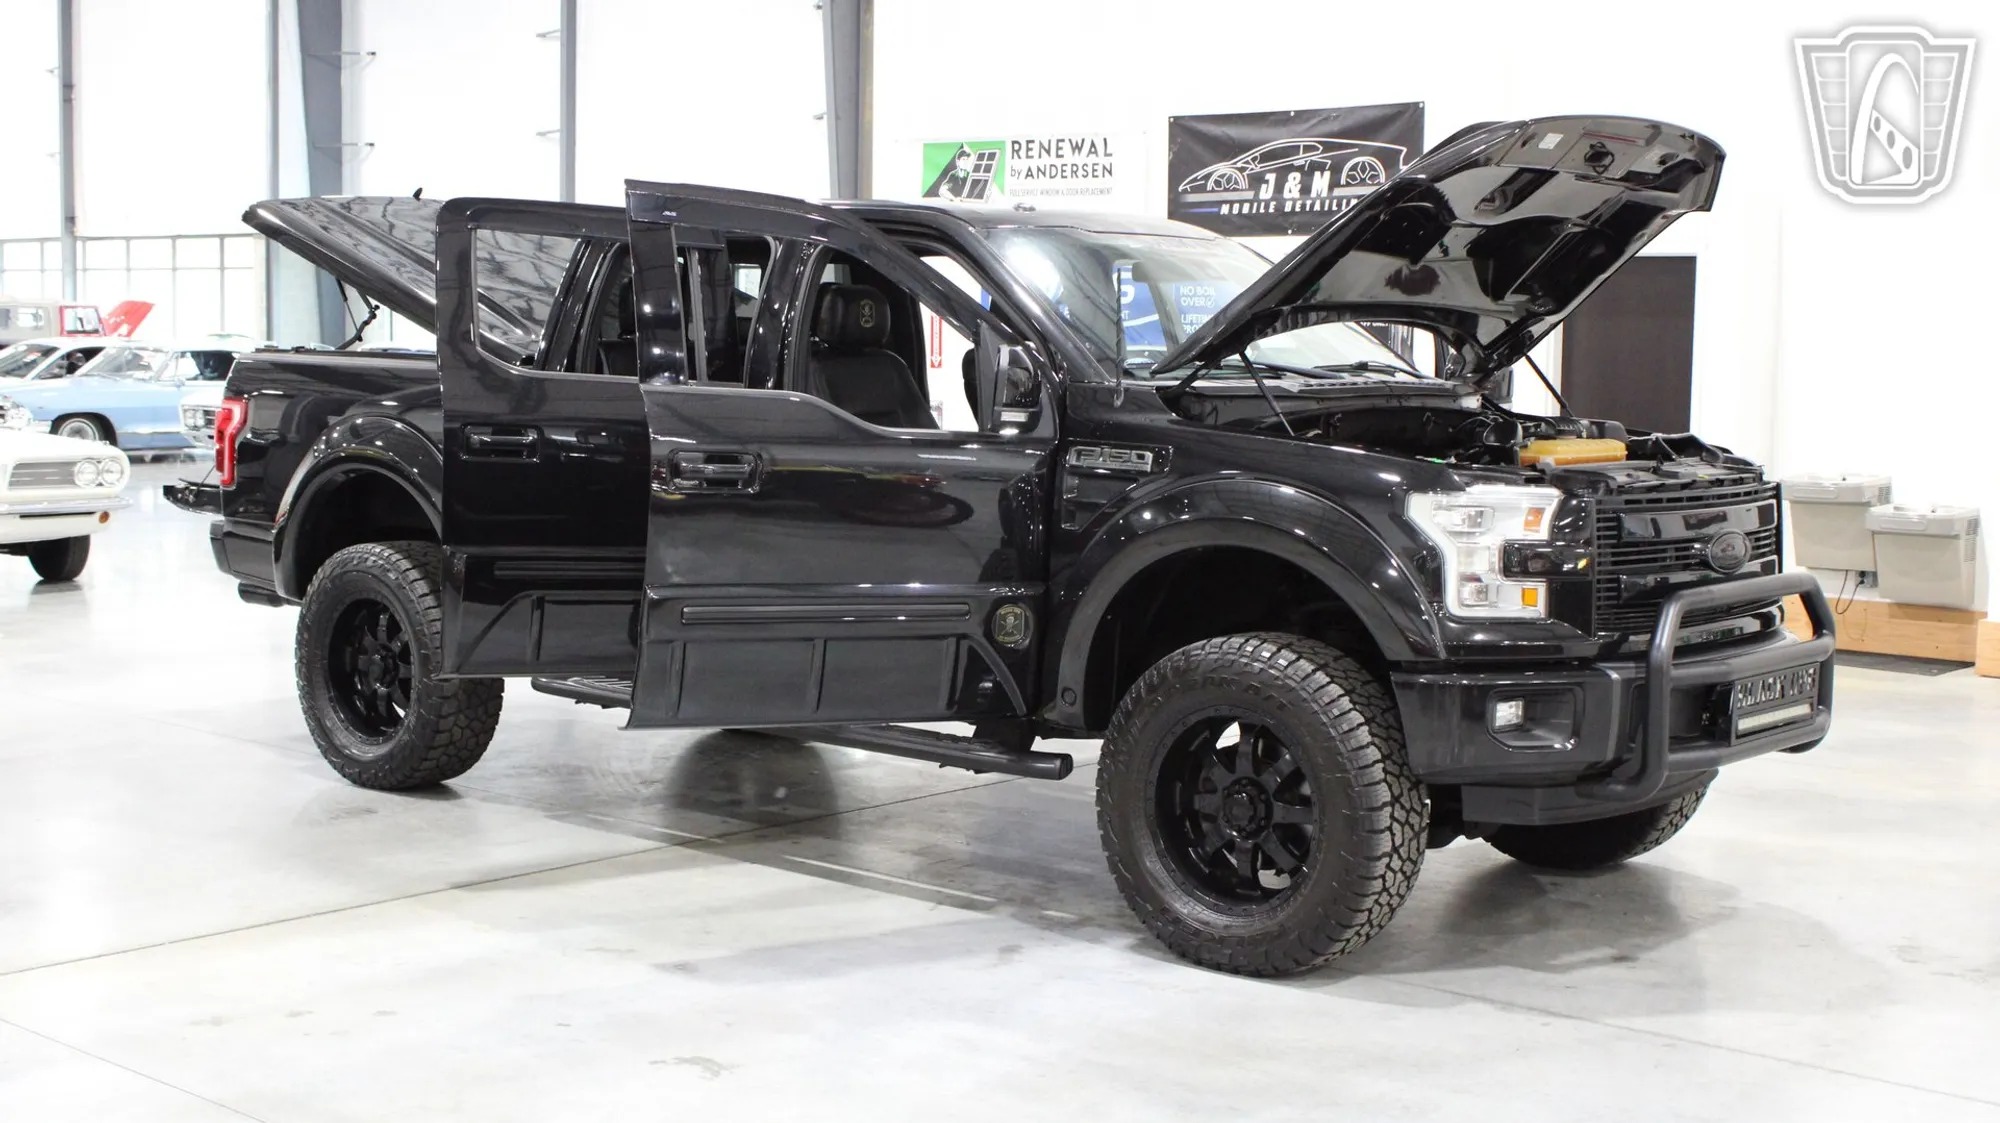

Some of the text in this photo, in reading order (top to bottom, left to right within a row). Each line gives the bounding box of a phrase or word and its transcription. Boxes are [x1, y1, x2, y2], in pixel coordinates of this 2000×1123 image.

[1010, 137, 1113, 160] RENEWAL
[1010, 162, 1113, 180] by ANDERSEN
[1258, 170, 1331, 200] J & M
[1220, 197, 1359, 215] MOBILE DETAILIN
[1180, 286, 1216, 296] NO BOIL
[1180, 297, 1206, 306] OVER
[1737, 674, 1787, 709] BLACK
